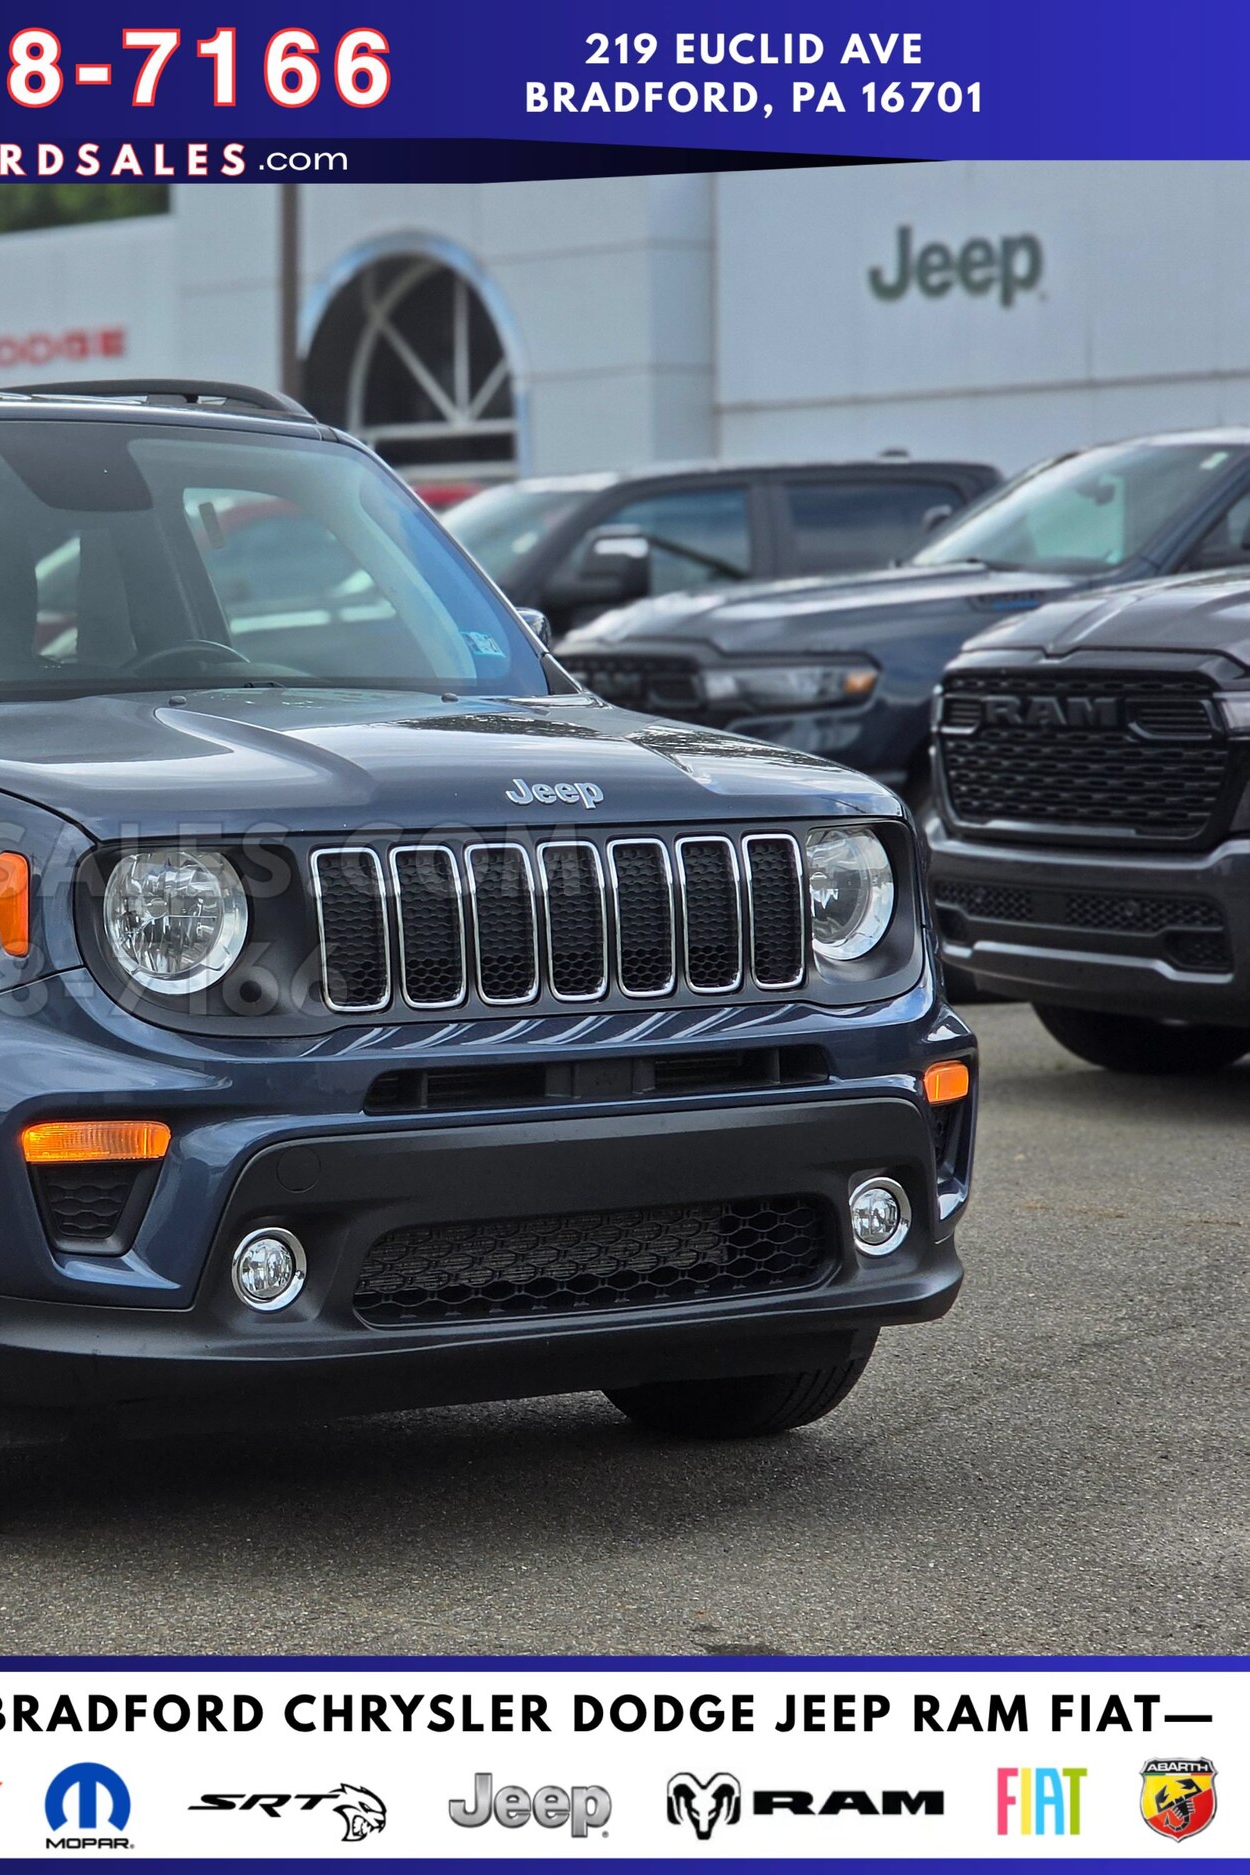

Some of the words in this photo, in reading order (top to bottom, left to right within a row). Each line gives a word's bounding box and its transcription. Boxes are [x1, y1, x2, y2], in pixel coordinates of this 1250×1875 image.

[868, 223, 1046, 309] Jeep
[981, 694, 1118, 728] RAM
[505, 778, 604, 809] Jeep
